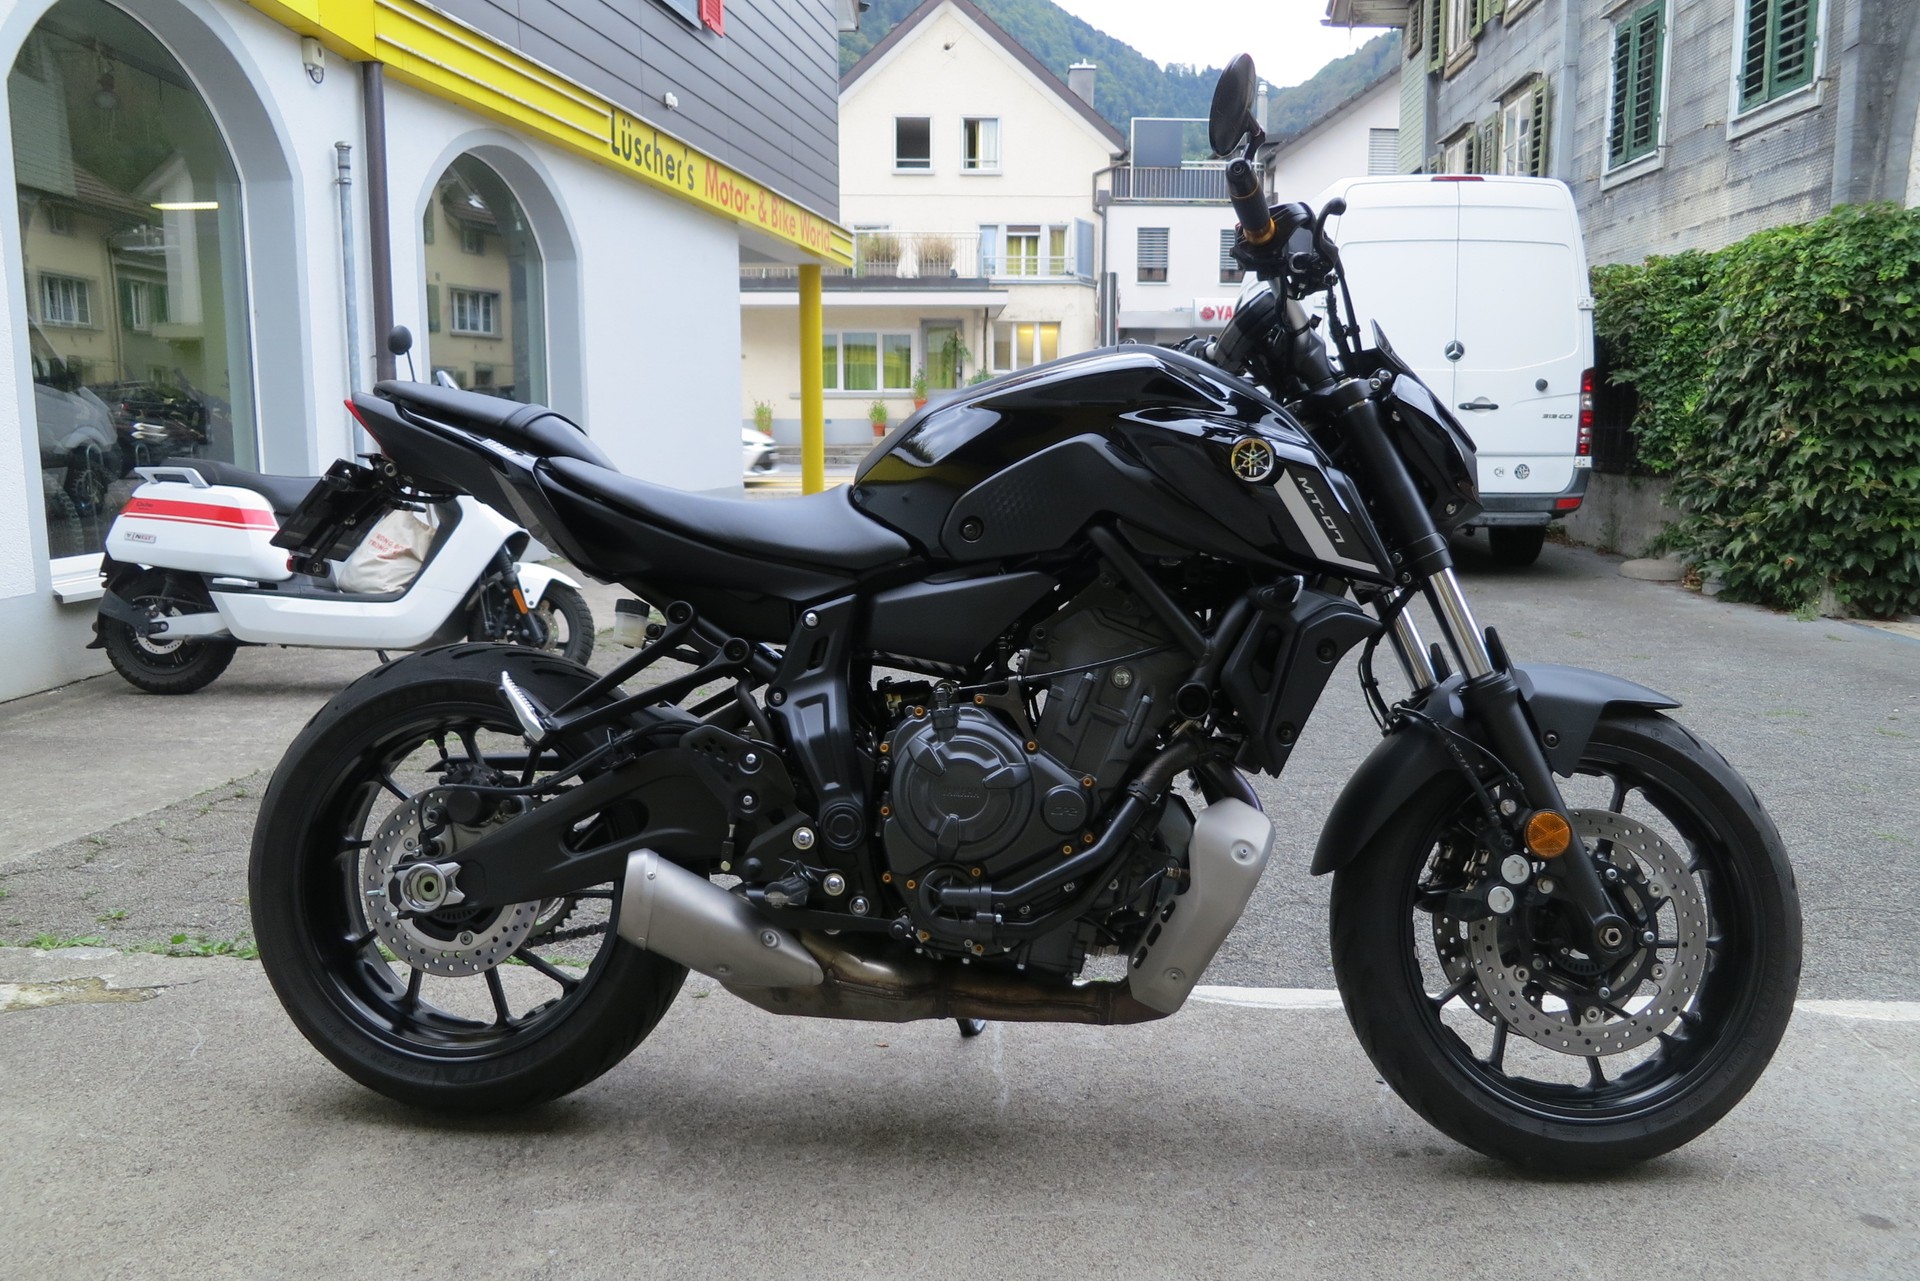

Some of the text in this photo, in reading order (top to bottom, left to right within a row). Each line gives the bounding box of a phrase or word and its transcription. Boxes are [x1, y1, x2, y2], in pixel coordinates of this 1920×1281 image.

[610, 108, 695, 191] Lüscher's
[758, 191, 767, 224] &
[771, 196, 796, 237] Bike
[799, 211, 832, 252] World
[1297, 477, 1345, 543] MT-07
